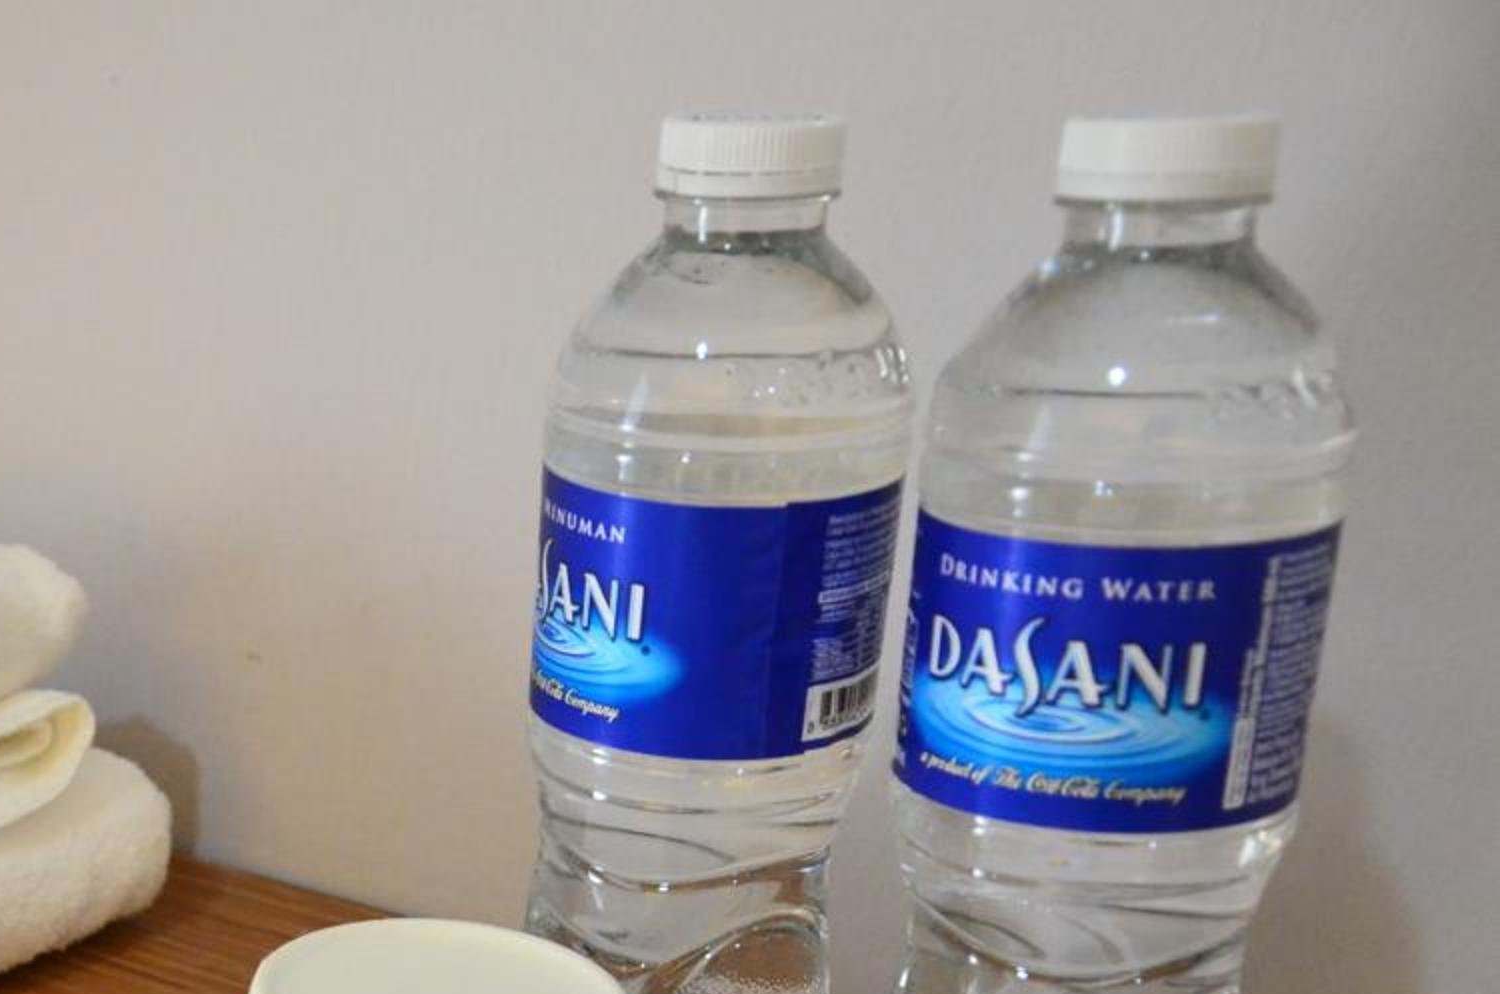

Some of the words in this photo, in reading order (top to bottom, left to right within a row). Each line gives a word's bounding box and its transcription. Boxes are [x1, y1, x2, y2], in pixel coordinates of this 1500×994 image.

[537, 538, 644, 640] SANI
[940, 553, 1083, 599] DRINKING
[1102, 577, 1216, 601] WATER
[929, 614, 1207, 717] DASANI
[1104, 780, 1187, 807] Company
